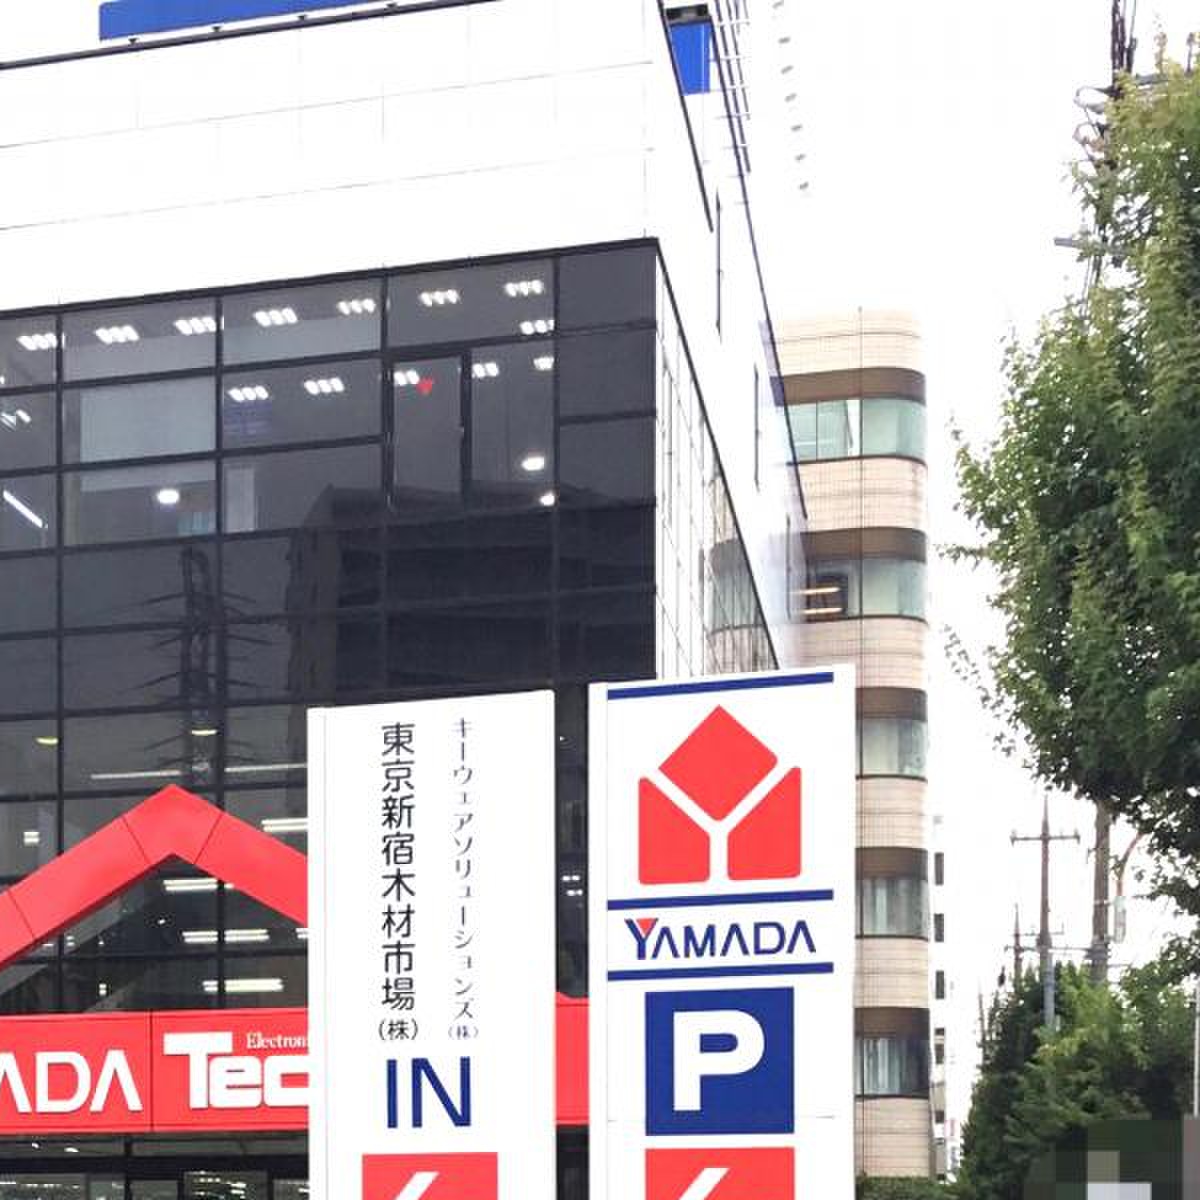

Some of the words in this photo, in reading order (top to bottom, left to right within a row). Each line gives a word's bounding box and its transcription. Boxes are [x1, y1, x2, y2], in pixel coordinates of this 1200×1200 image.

[624, 918, 817, 961] YAMADA
[386, 1055, 472, 1129] IN
[672, 1009, 766, 1112] P
